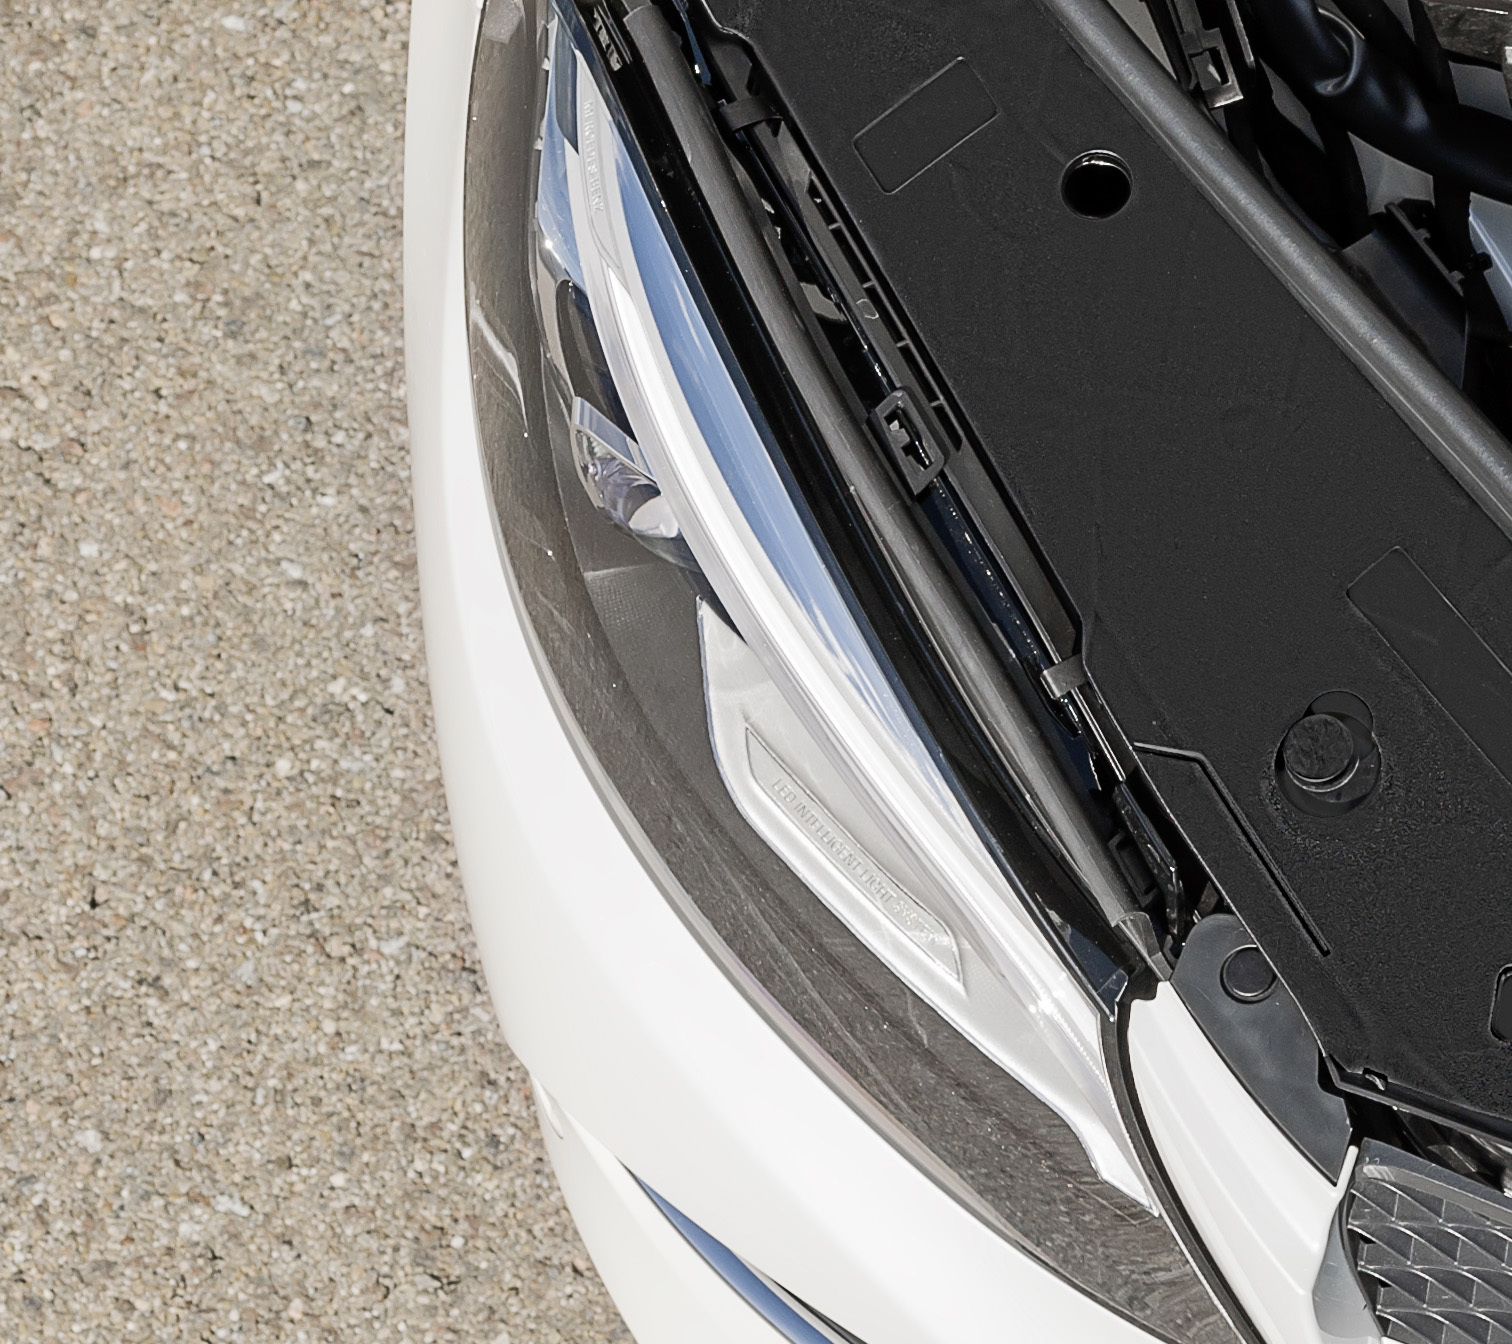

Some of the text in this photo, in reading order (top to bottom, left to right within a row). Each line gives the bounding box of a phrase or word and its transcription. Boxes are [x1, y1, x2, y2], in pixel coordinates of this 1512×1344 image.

[772, 778, 797, 803] LED
[795, 800, 863, 872] INTELLIGENT
[860, 868, 896, 903] LIGHT
